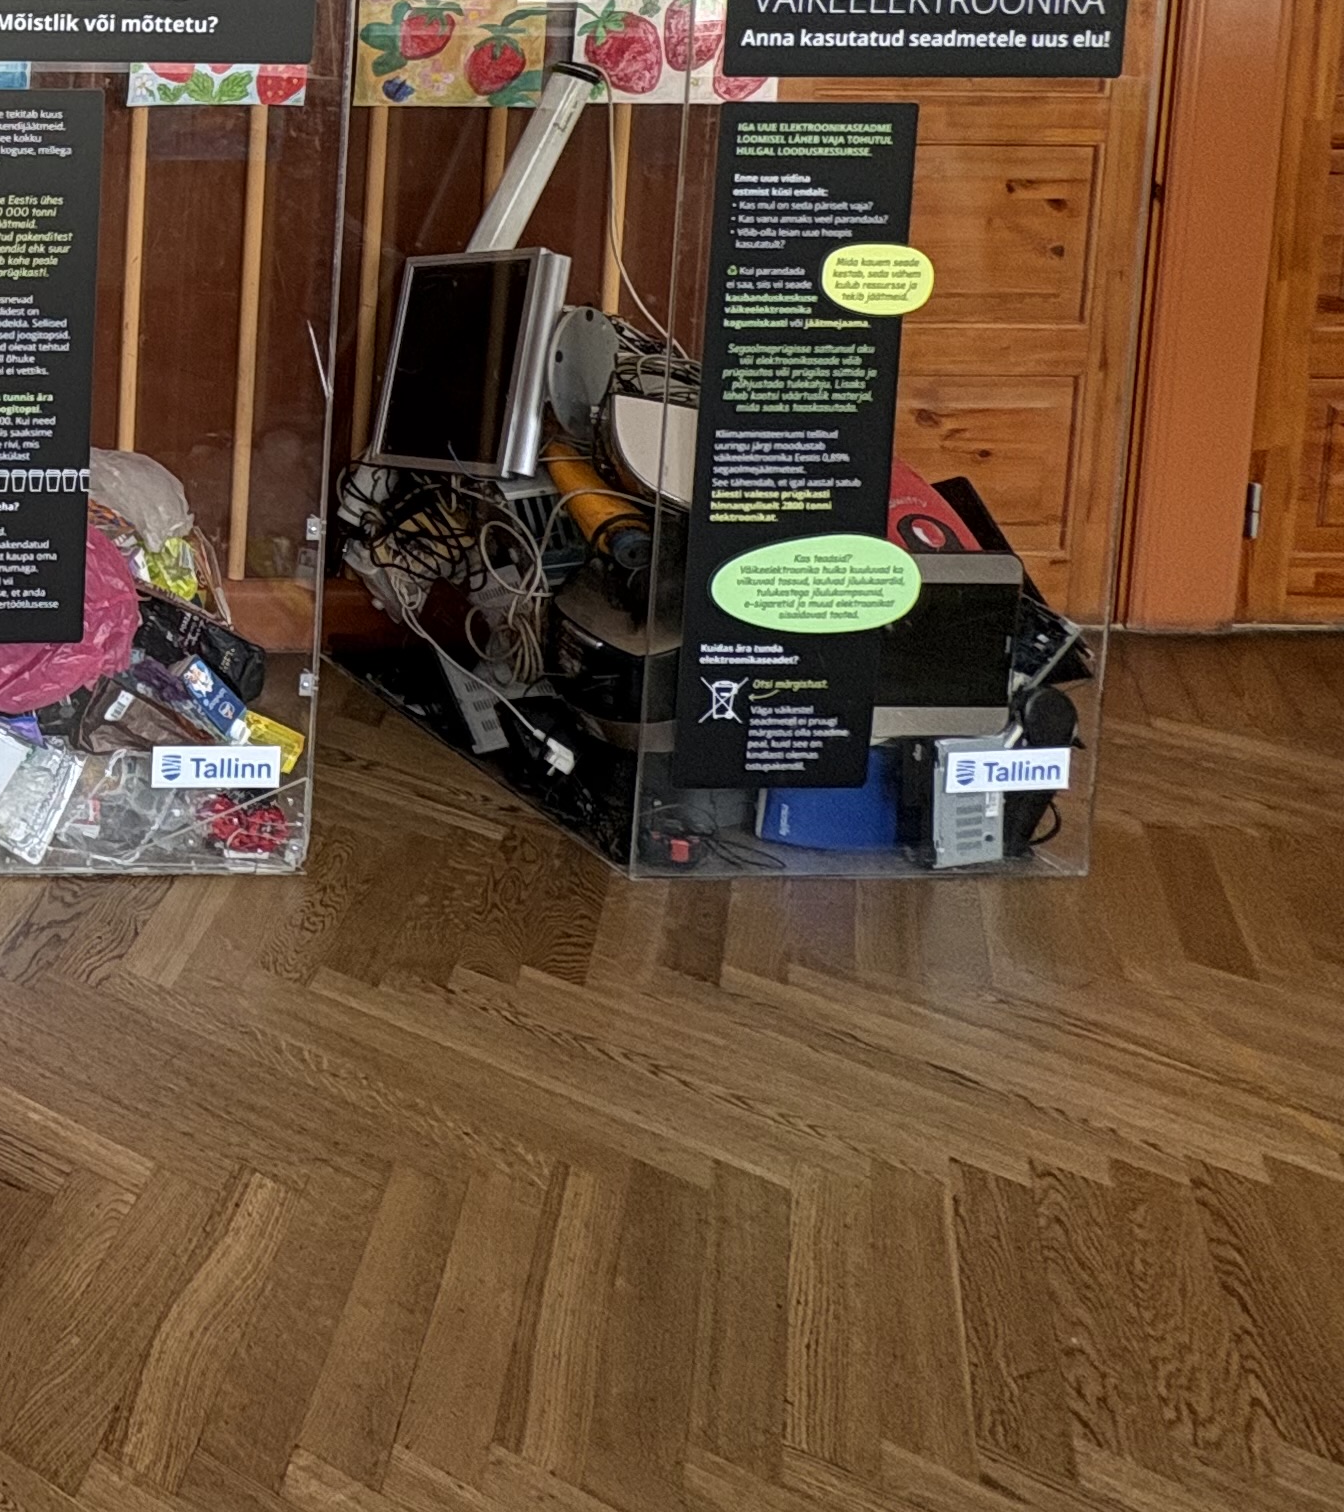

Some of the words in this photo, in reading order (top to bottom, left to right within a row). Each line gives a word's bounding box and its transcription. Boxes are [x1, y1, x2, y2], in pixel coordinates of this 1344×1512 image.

[82, 14, 115, 33] või
[121, 14, 218, 34] mõttetu?
[741, 30, 794, 47] Anna
[801, 30, 903, 47] kasutatud
[910, 30, 1026, 48] seadmetele
[1032, 34, 1067, 48] uus
[1074, 31, 1110, 48] elu!
[6, 111, 38, 119] tekitab
[40, 111, 63, 119] kuus
[13, 134, 42, 143] kokku
[8, 196, 38, 205] Eestis
[40, 196, 63, 205] ühes
[6, 208, 29, 217] 000
[32, 208, 56, 217] tonni
[190, 756, 272, 779] Tallinn
[984, 762, 1060, 782] Tallinn
